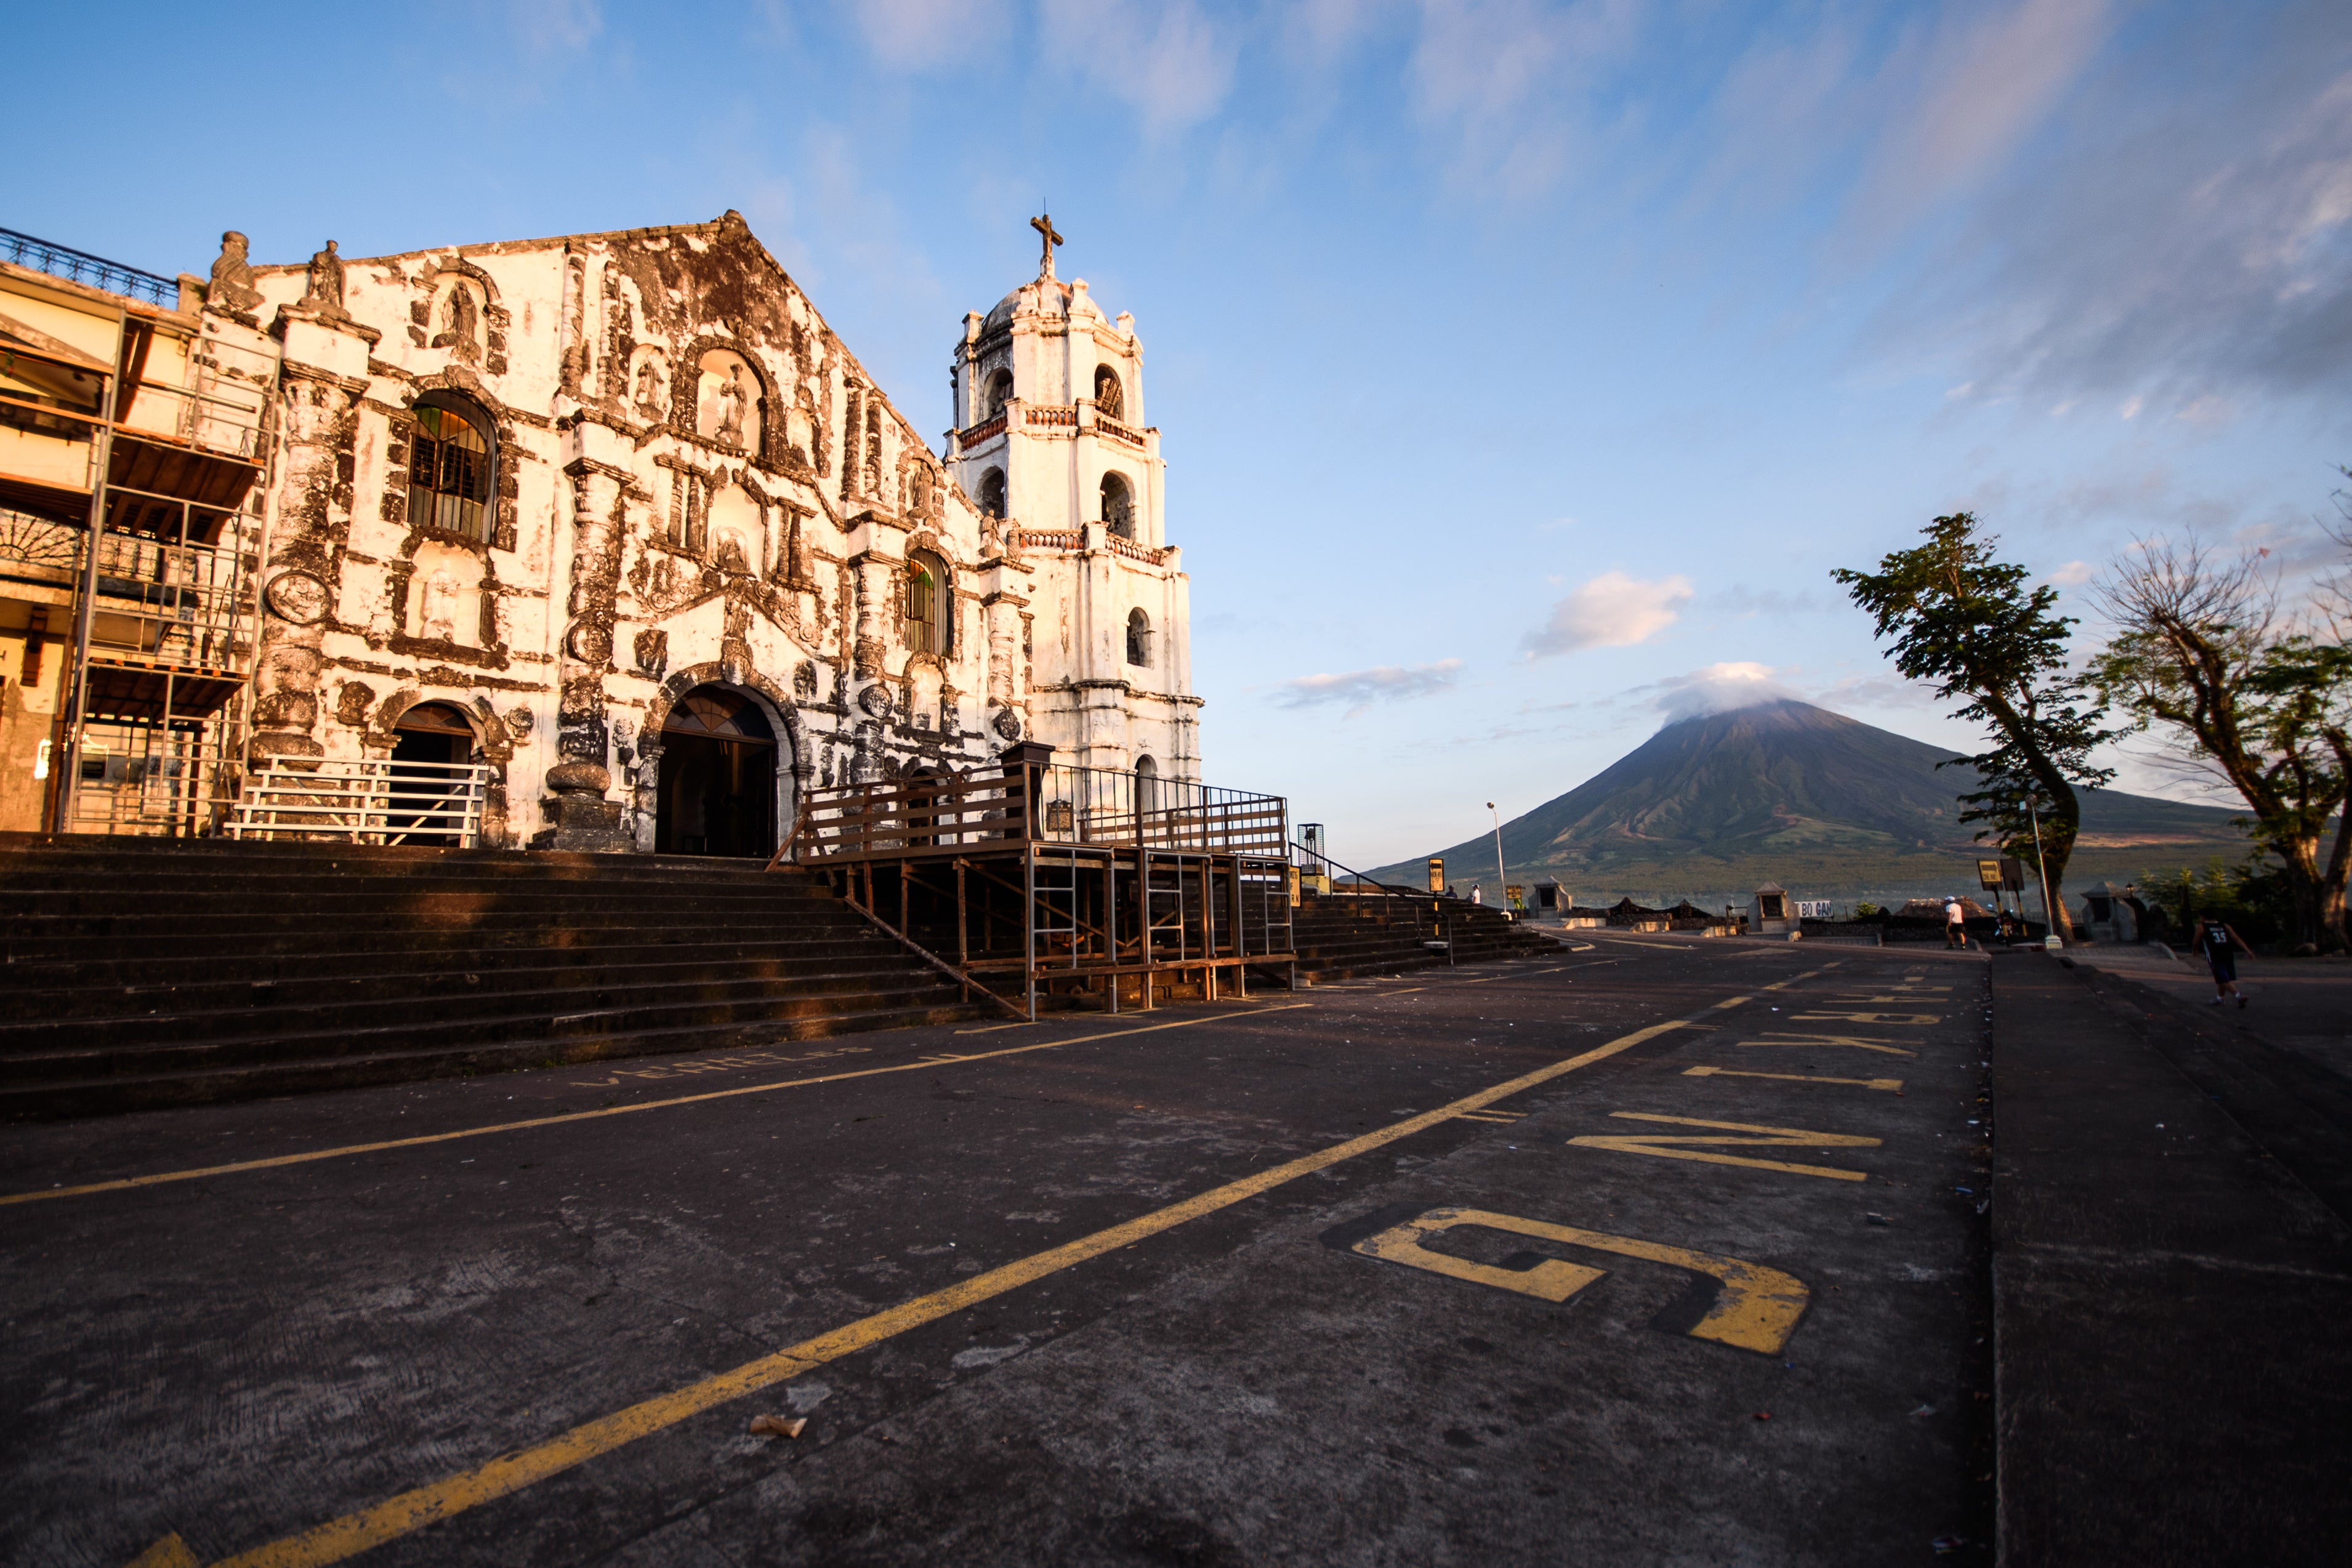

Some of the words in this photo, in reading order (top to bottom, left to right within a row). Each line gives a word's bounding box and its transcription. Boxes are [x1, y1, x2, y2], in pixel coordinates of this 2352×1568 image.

[1802, 903, 1813, 917] BO
[1816, 901, 1833, 916] GAN
[569, 1047, 872, 1086] VEHICLES
[611, 1051, 777, 1075] LIGHT
[1352, 985, 1954, 1354] PARKING
